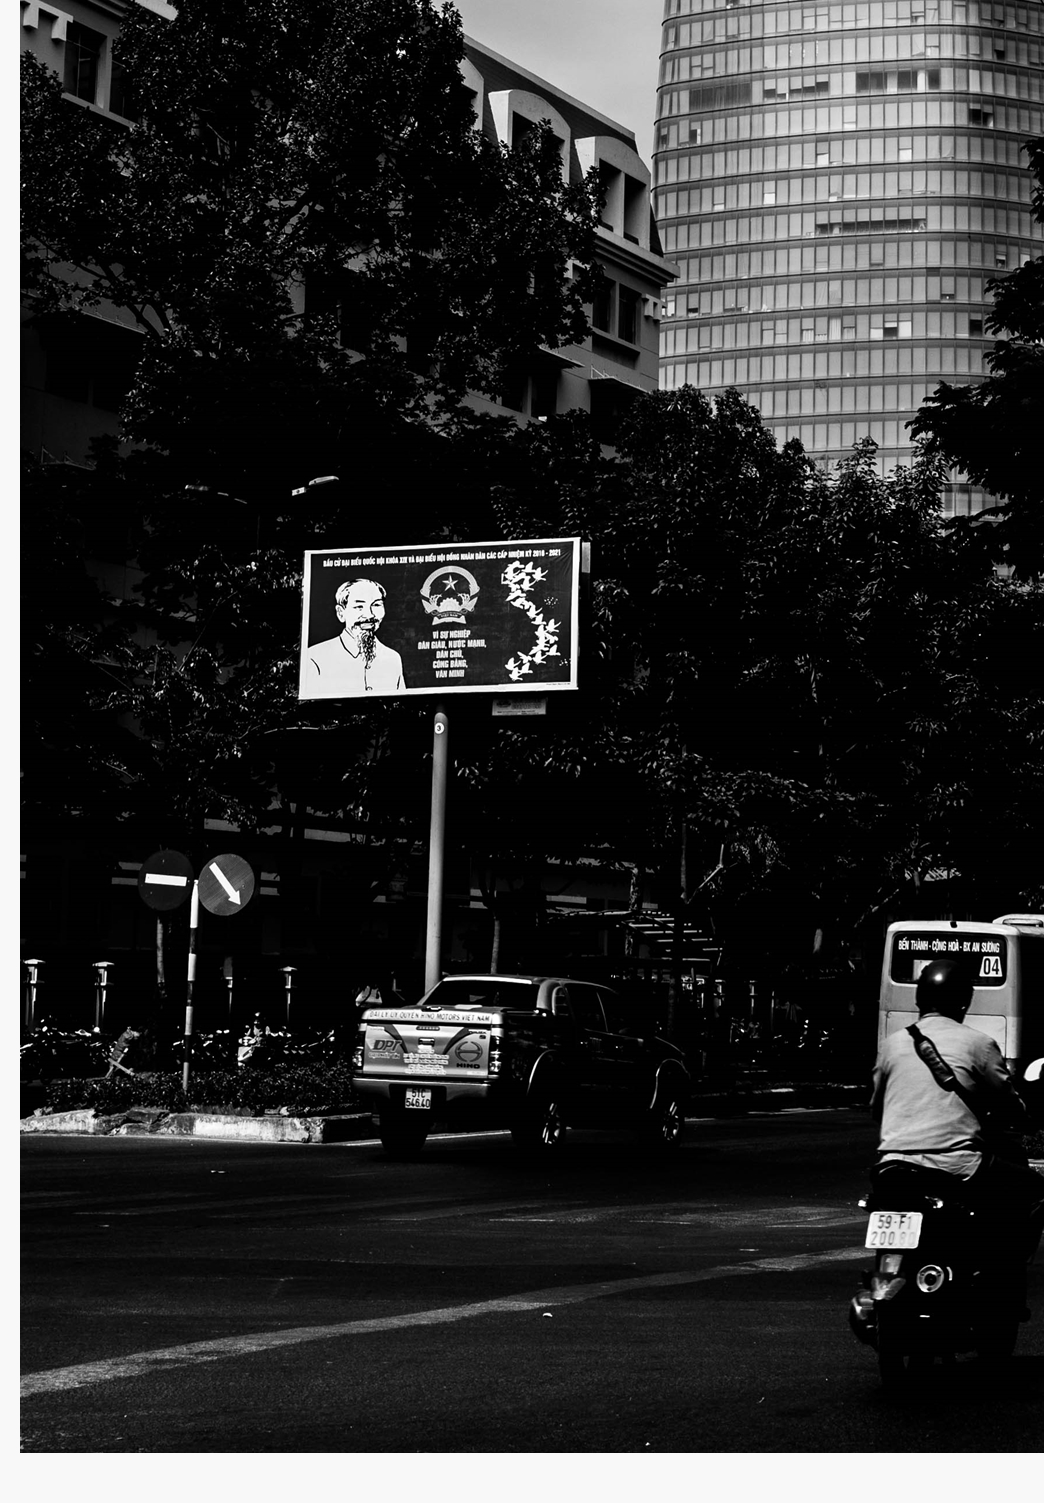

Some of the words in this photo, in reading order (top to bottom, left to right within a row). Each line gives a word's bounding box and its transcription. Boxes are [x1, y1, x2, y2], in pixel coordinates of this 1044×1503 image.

[898, 937, 910, 950] BẾN
[910, 938, 929, 950] THÀNH
[932, 938, 947, 953] CỘNG
[948, 939, 959, 951] HOÀ
[963, 942, 971, 952] BX
[971, 942, 980, 952] AN
[983, 958, 1000, 975] 04
[436, 1013, 460, 1021] MOTORS
